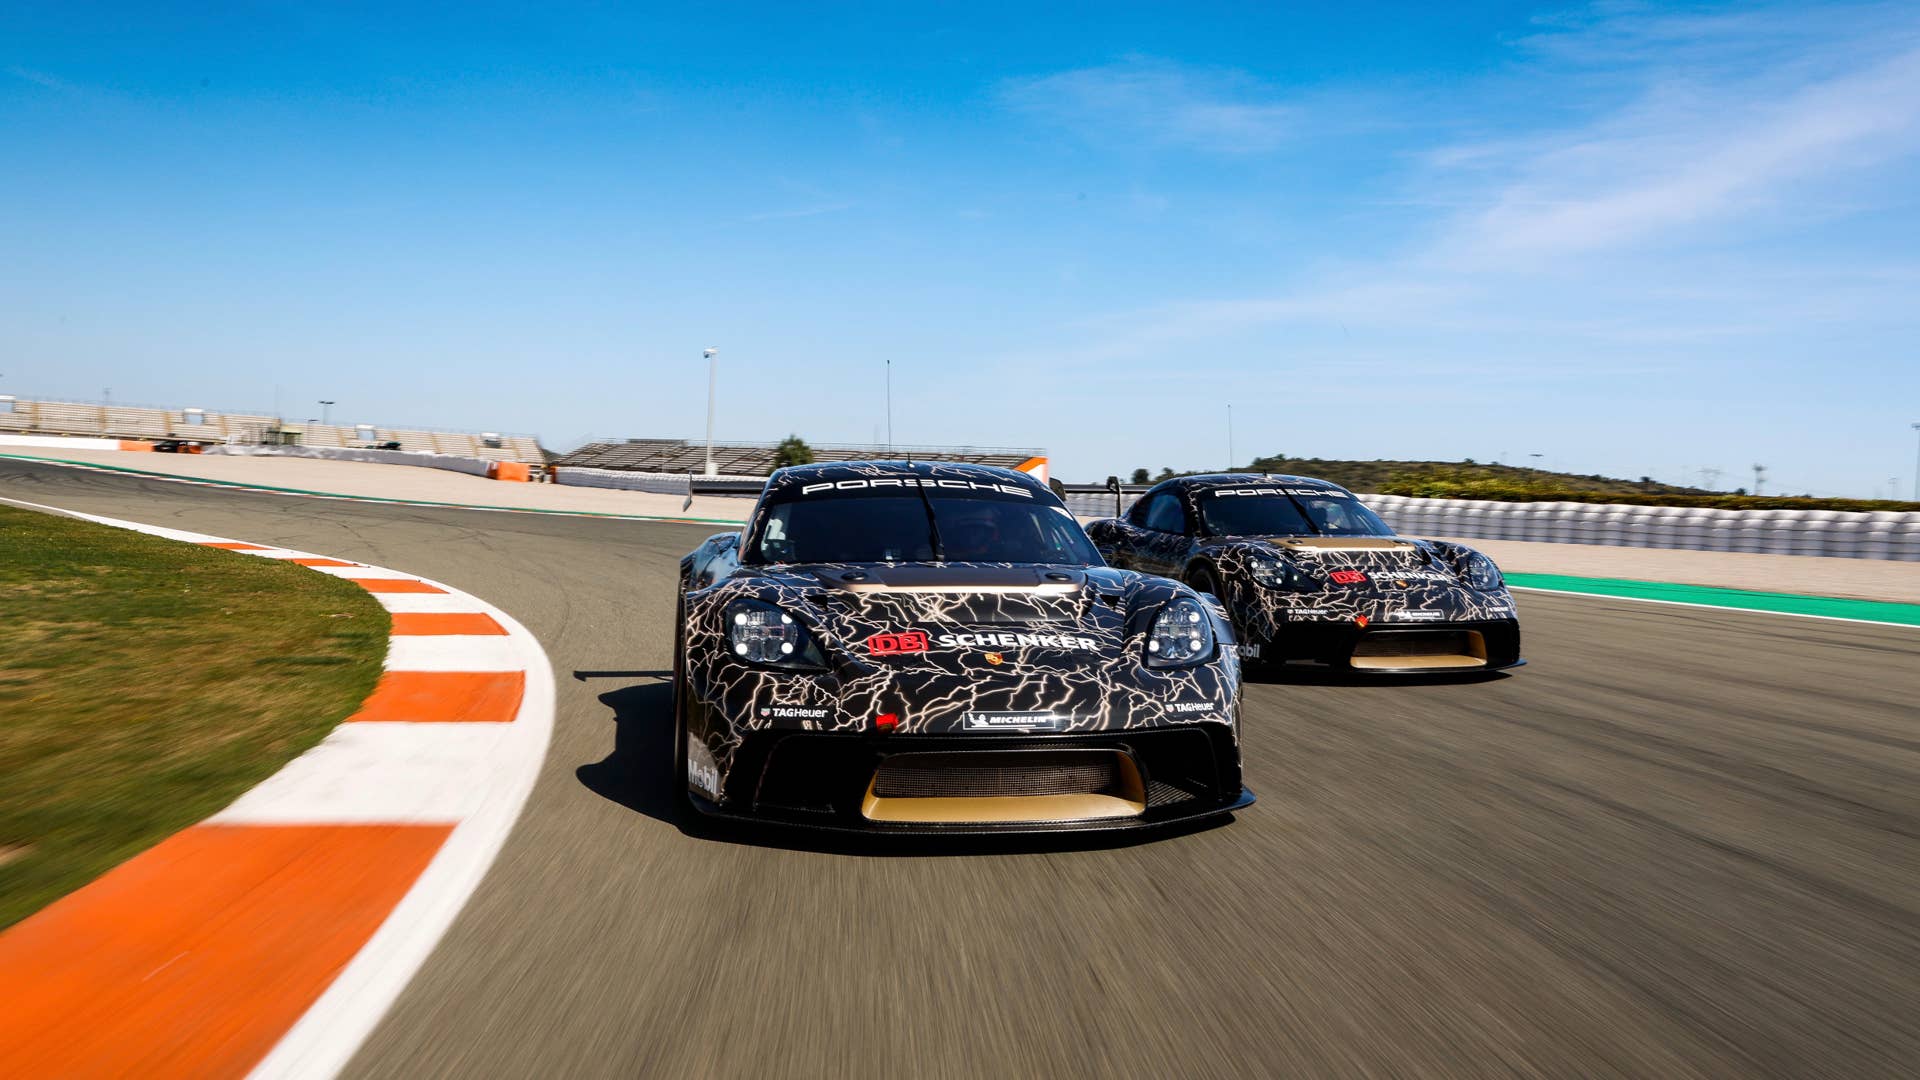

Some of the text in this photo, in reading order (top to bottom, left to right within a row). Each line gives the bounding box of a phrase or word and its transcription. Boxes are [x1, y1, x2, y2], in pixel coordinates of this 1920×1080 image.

[802, 479, 1033, 498] PORSCHE
[1215, 488, 1349, 498] PORSCHE
[875, 633, 1099, 652] DB SCHENKER
[1237, 642, 1260, 658] obil
[772, 708, 829, 718] TAGHeuer
[989, 716, 1047, 724] MICHELIN
[688, 759, 718, 795] Mobil
